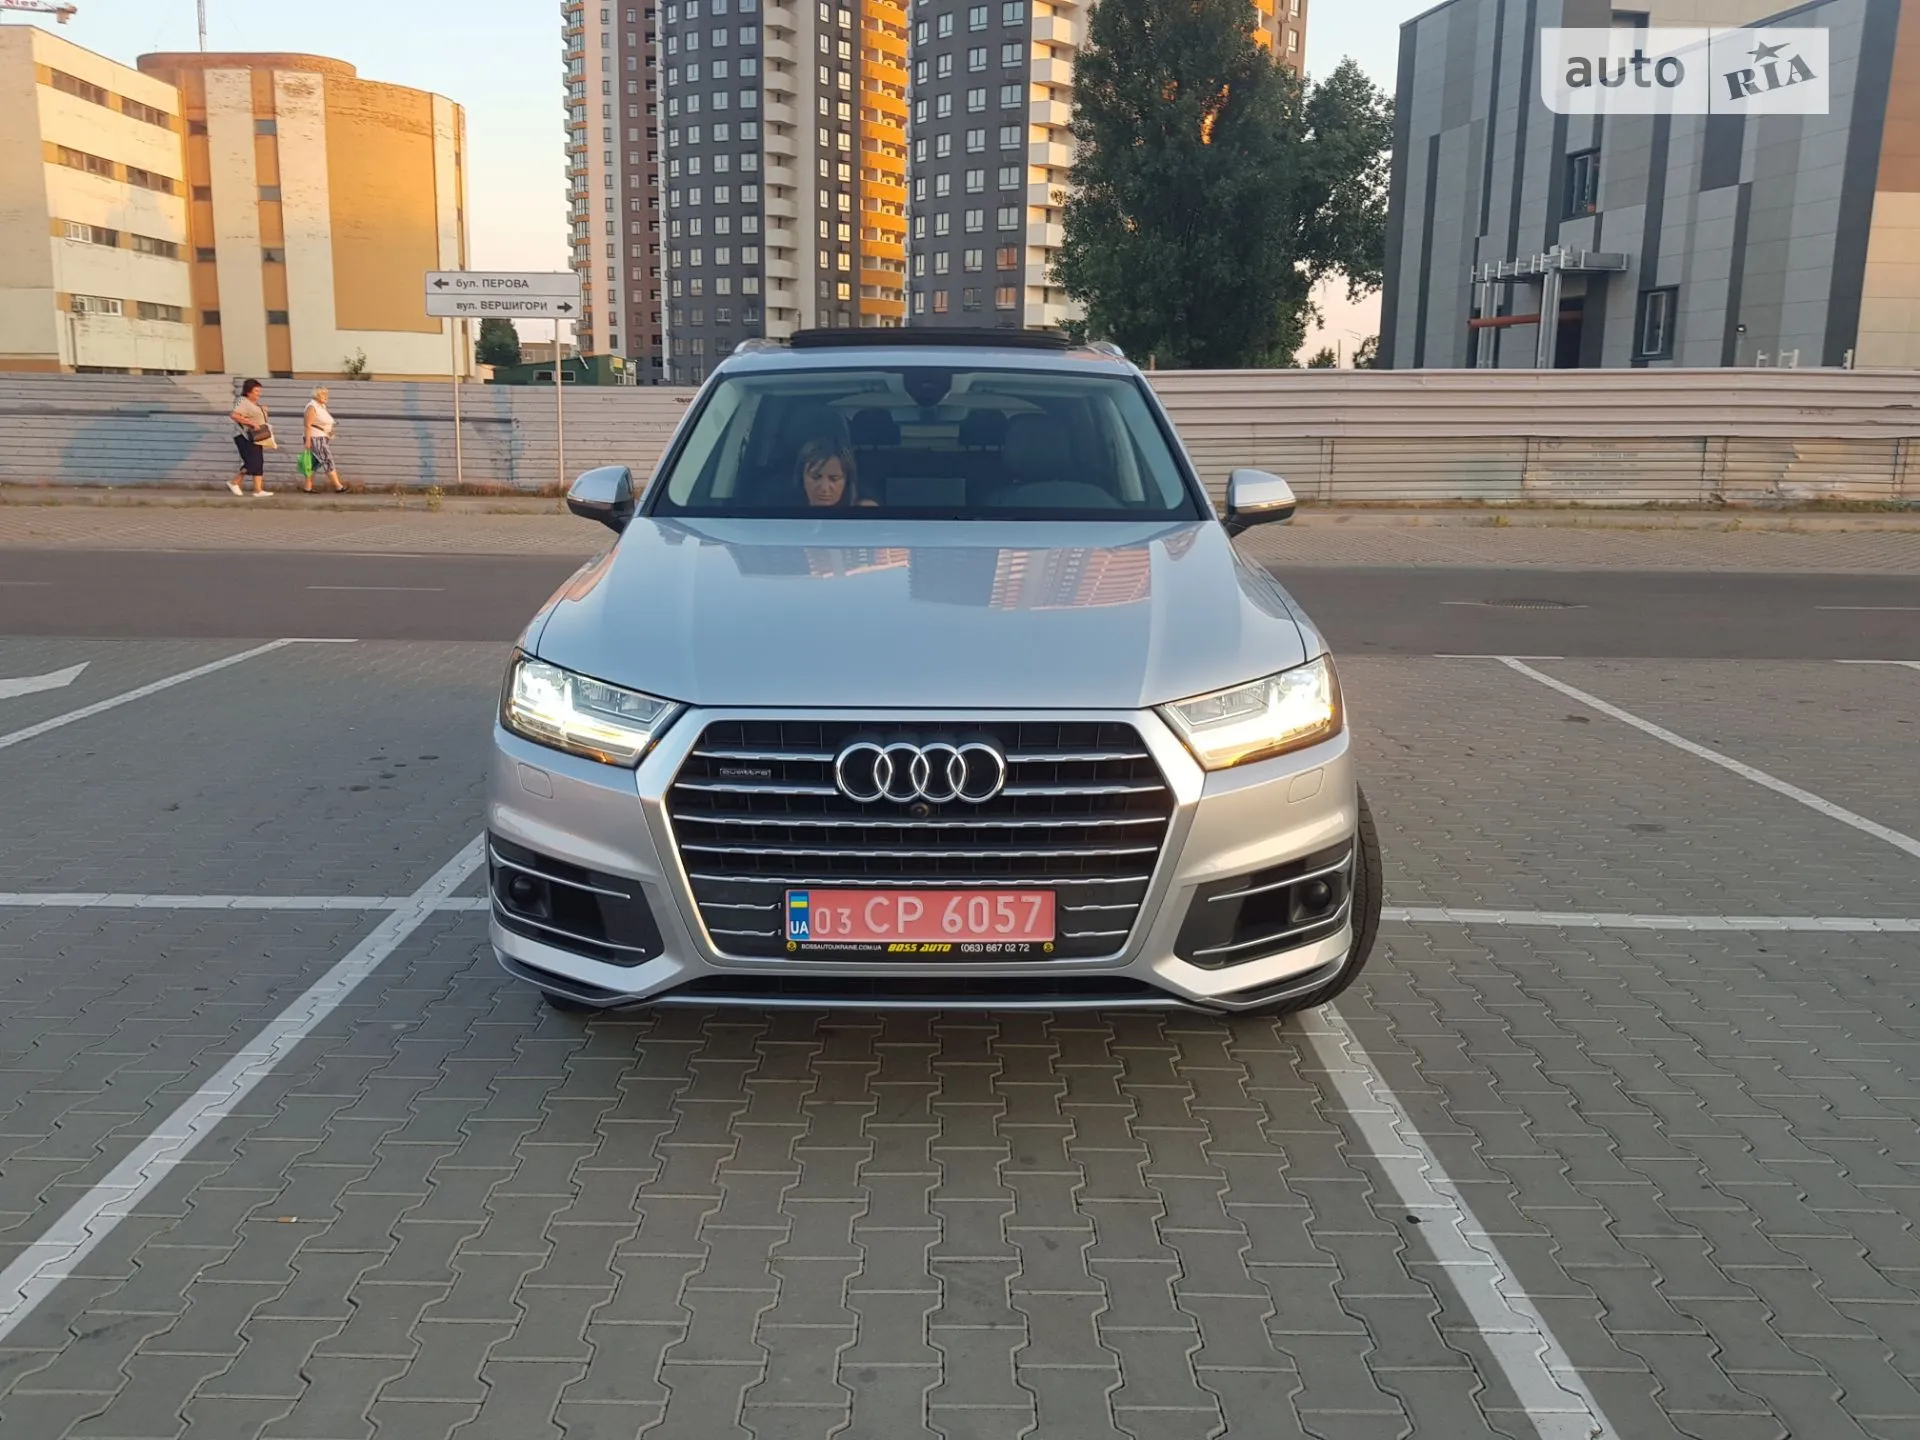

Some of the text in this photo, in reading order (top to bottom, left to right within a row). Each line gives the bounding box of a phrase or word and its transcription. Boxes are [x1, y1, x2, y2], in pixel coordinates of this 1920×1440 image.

[456, 278, 530, 290] бул. ПЕРОВА
[456, 301, 548, 312] вул. ВЕРШИГОРИ
[814, 895, 1043, 935] 03 CP 6057
[790, 920, 809, 935] UA
[887, 943, 917, 953] BOSS
[960, 943, 983, 953] (063)
[985, 943, 1002, 952] 667
[1004, 943, 1016, 953] 02
[1018, 943, 1030, 953] 72
